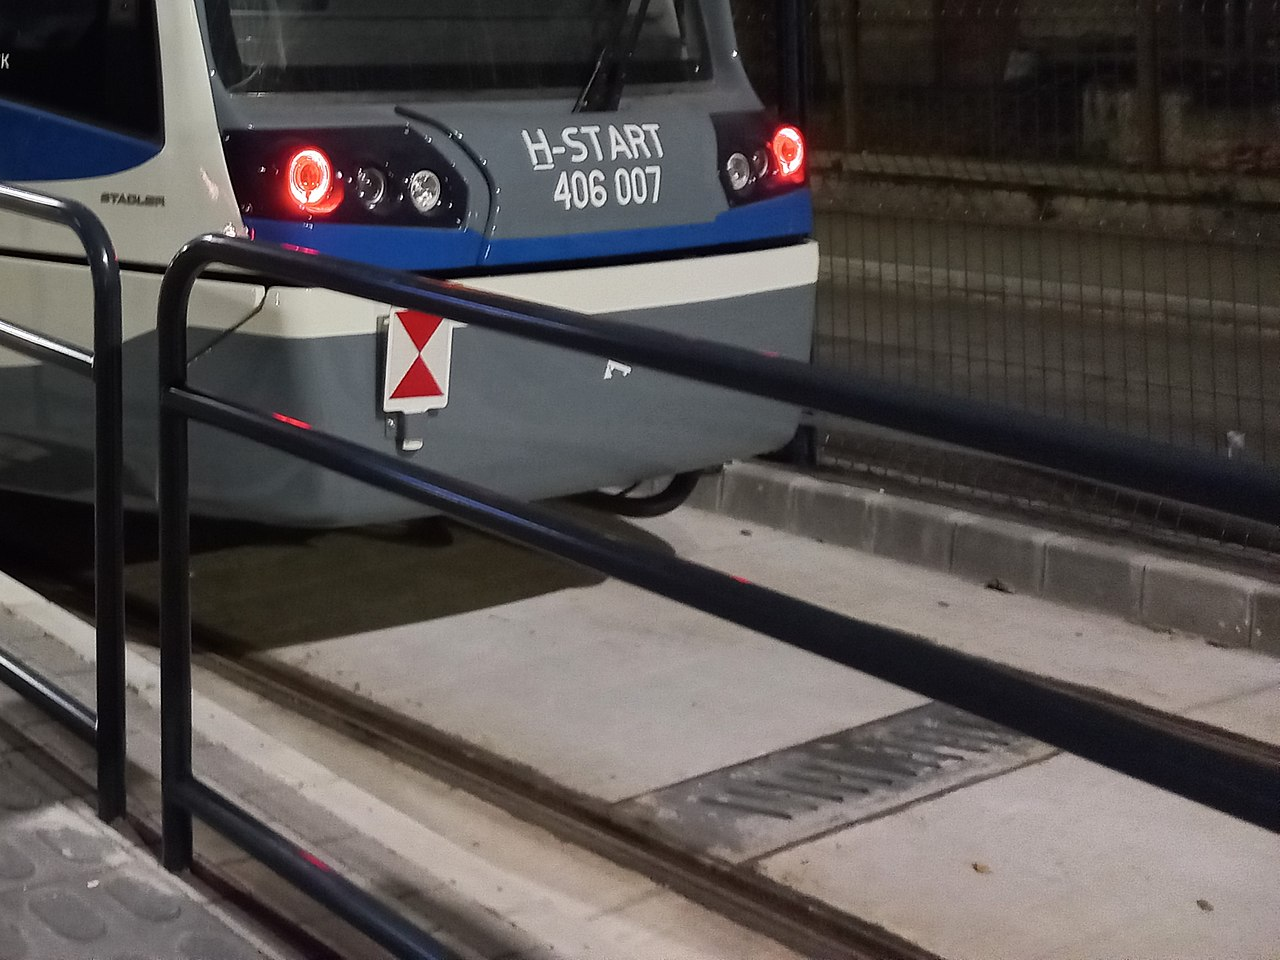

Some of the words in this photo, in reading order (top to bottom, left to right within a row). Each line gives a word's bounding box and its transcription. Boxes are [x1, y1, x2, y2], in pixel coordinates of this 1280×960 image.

[521, 123, 665, 171] H-START
[553, 168, 609, 211] 406
[614, 165, 661, 206] 007
